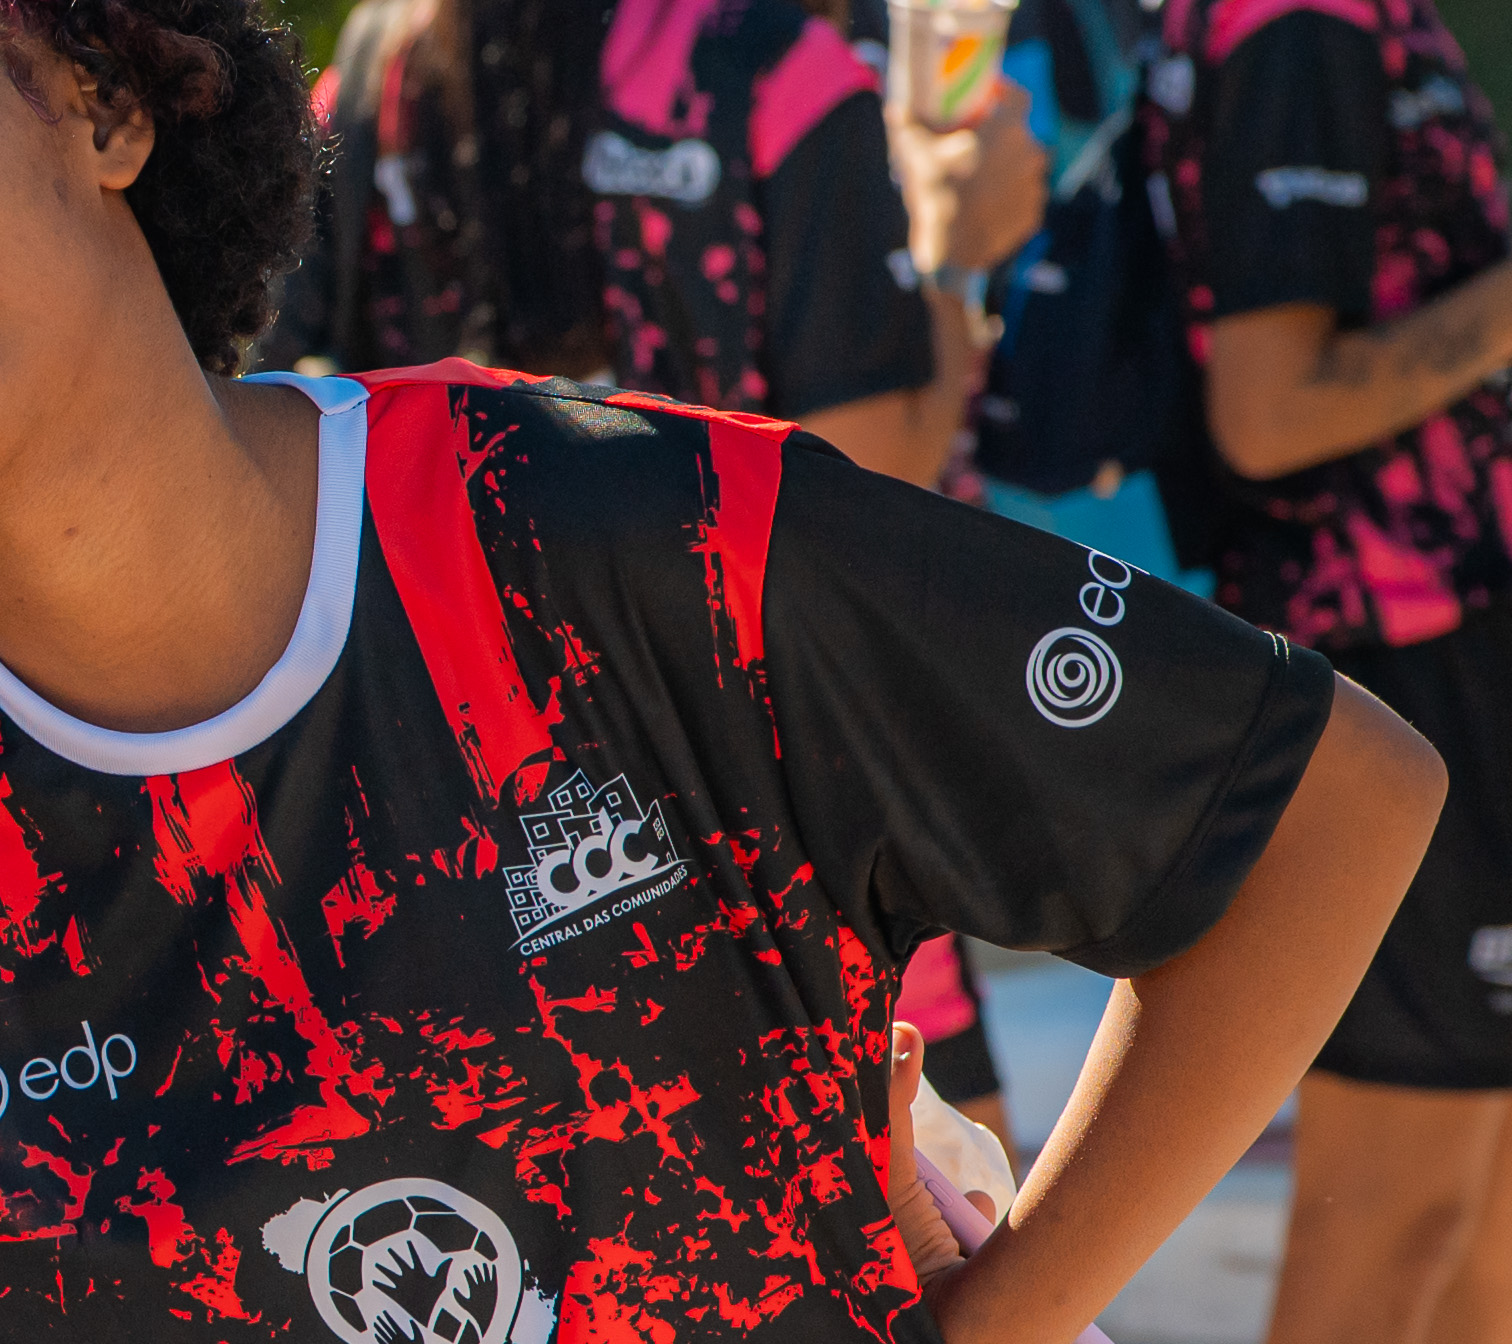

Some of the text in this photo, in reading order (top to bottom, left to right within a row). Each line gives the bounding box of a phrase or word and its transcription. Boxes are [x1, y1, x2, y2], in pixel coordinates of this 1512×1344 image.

[519, 863, 688, 956] CENTRAL DAS COMUNIDADES
[19, 1019, 137, 1101] edp
